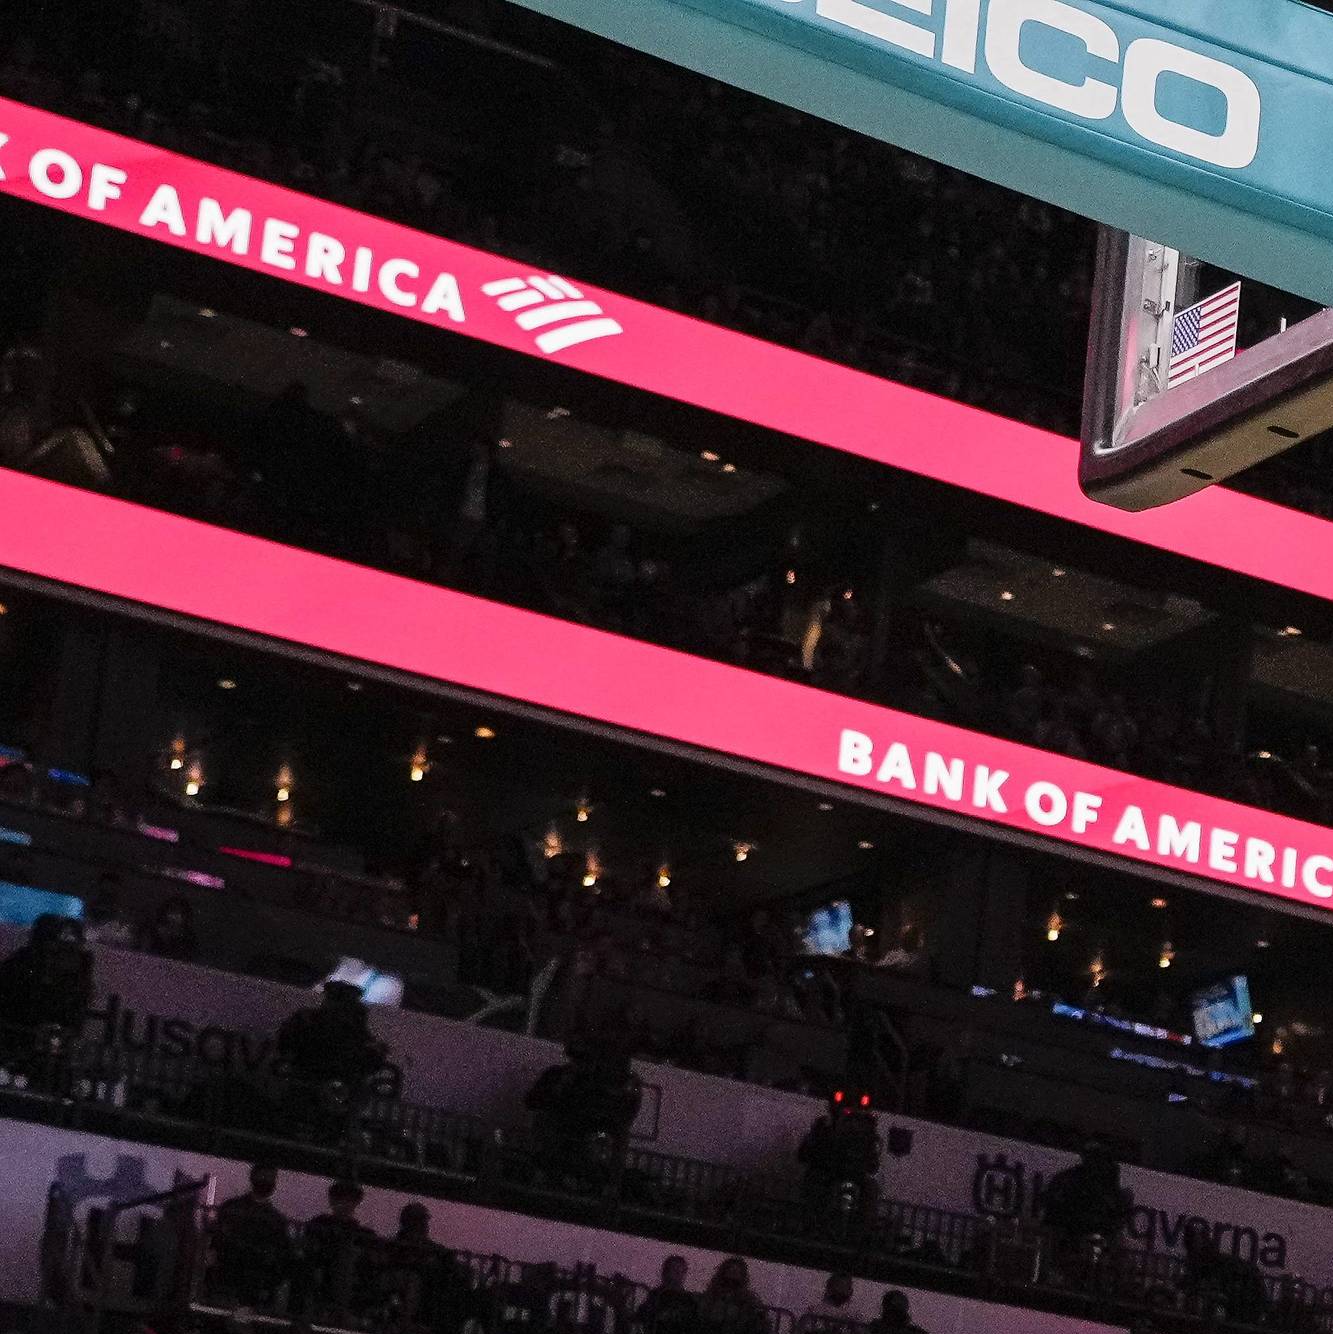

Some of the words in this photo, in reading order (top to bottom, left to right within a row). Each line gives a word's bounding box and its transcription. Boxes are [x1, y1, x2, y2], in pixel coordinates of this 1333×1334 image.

[29, 149, 126, 209] OF
[140, 185, 465, 321] AMERICA
[839, 730, 1009, 812] BANK
[1026, 782, 1102, 833] OF
